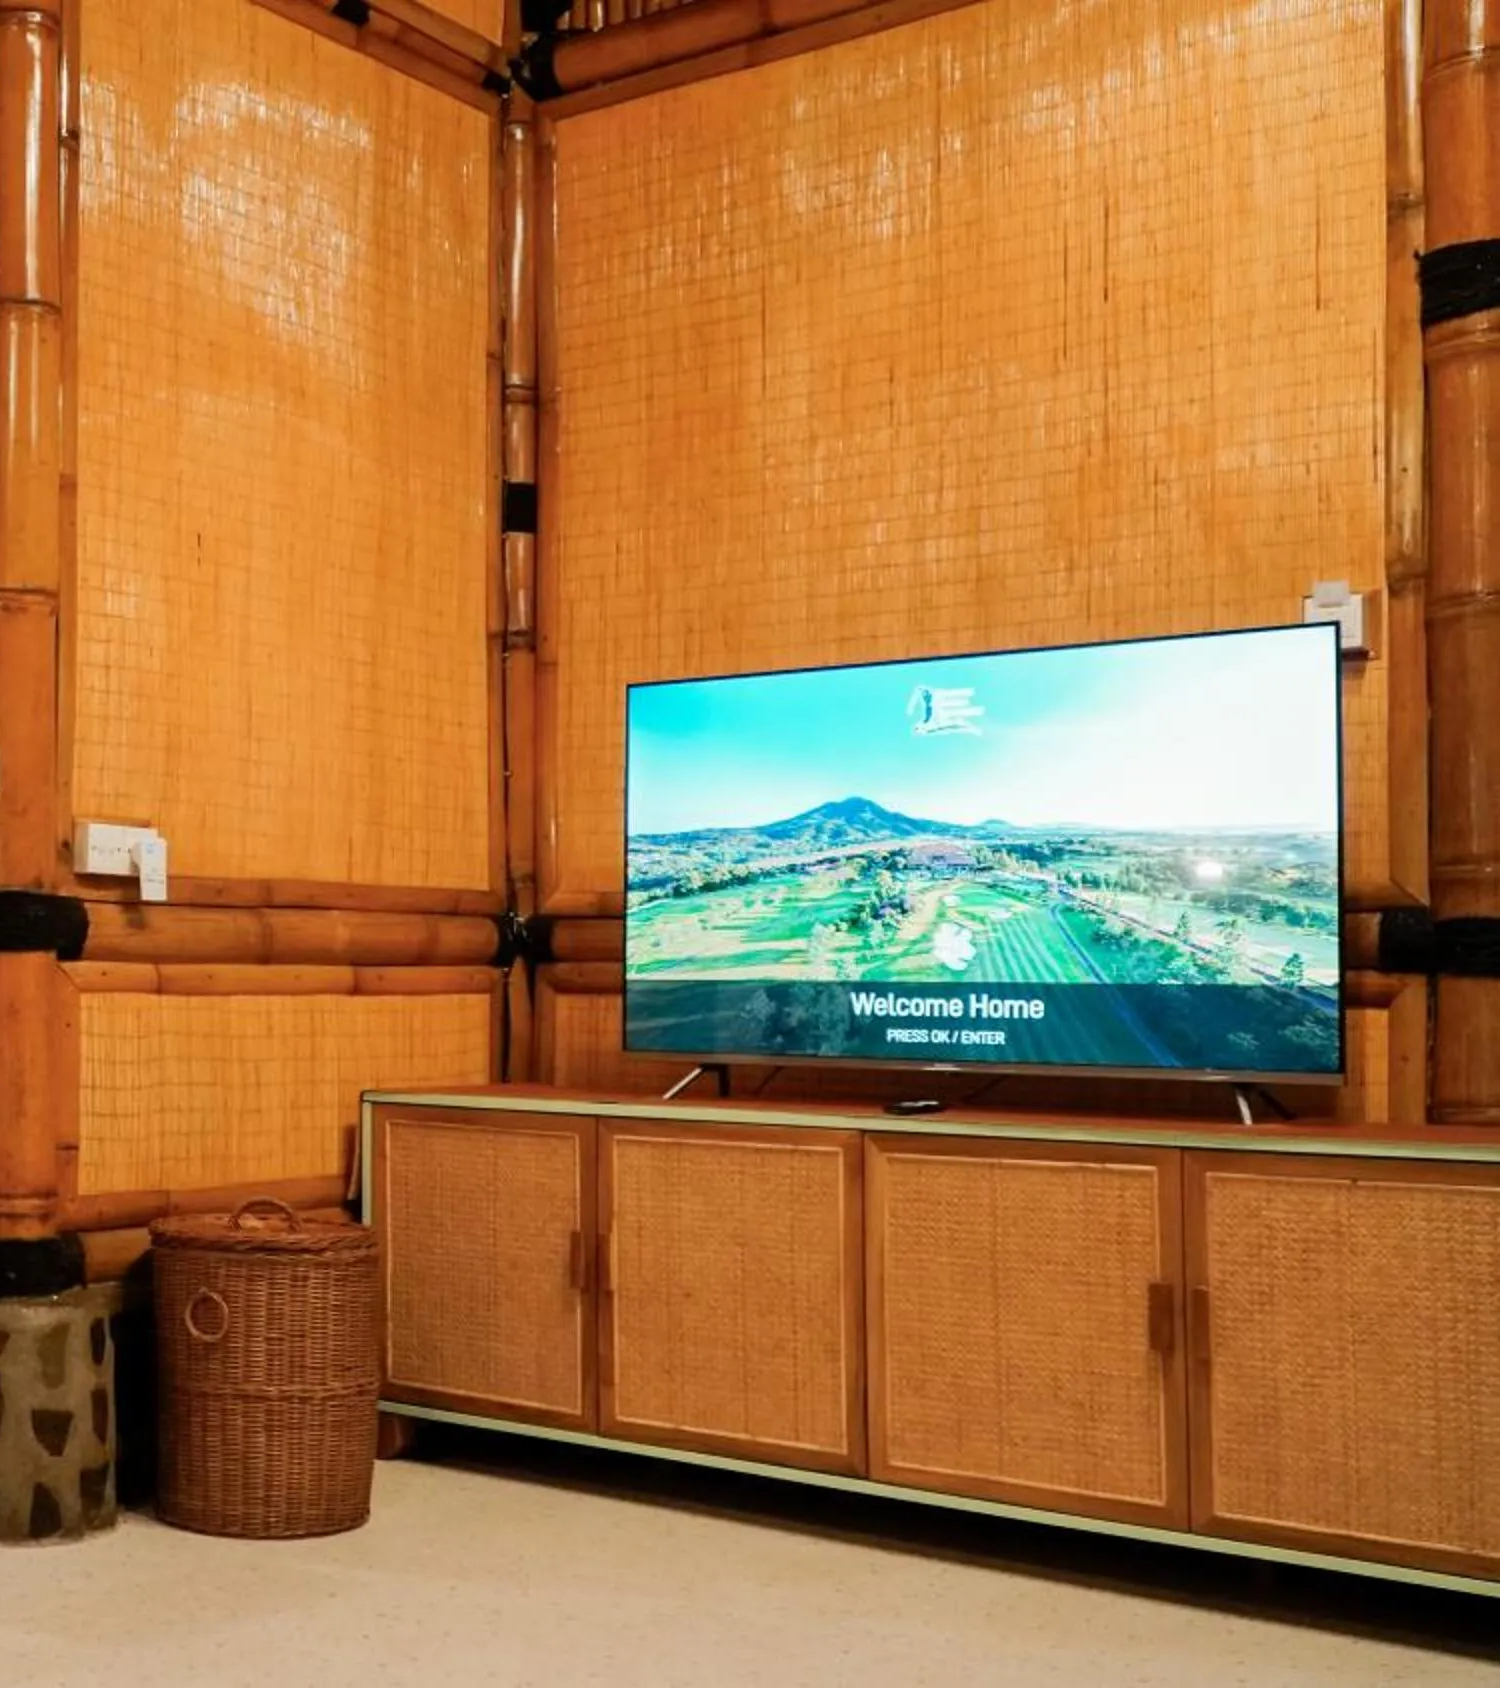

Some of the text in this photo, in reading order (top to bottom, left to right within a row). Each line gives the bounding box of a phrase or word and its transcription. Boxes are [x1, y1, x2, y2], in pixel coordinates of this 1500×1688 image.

[850, 991, 1045, 1020] Welcome Home
[886, 1028, 1006, 1045] PRESS OK / ENTER
